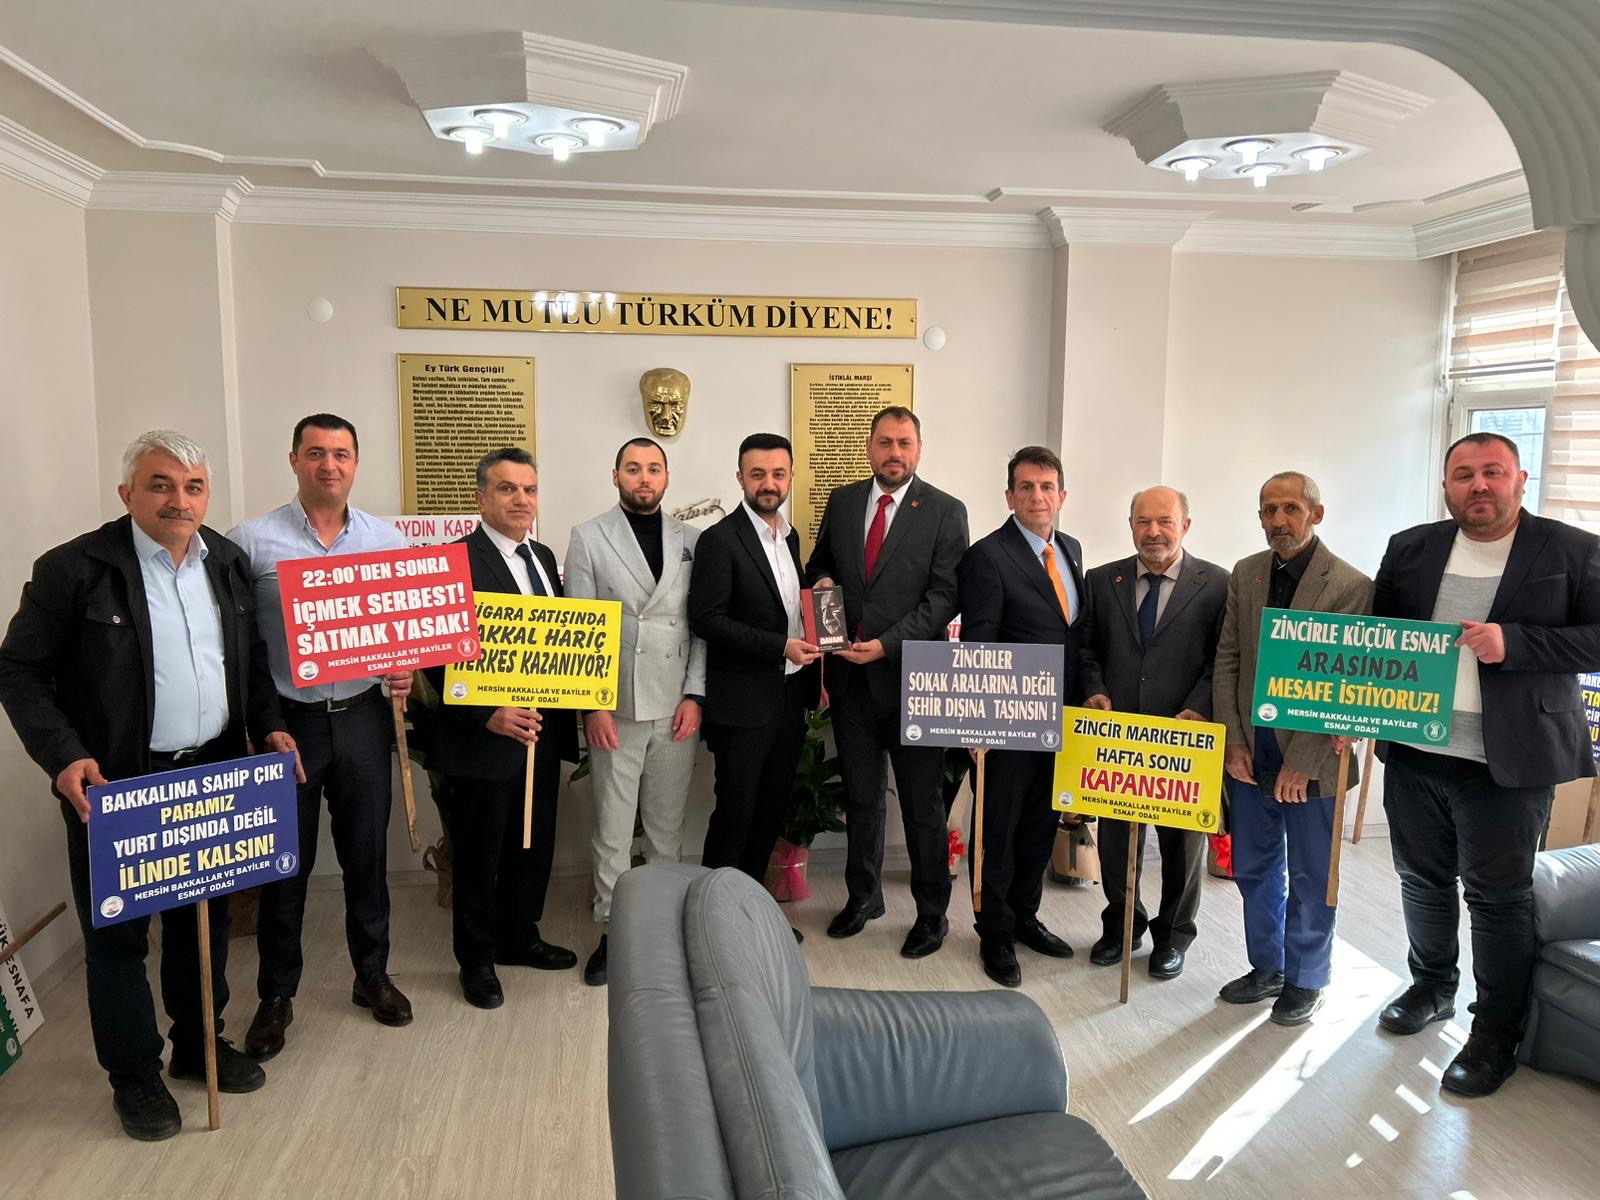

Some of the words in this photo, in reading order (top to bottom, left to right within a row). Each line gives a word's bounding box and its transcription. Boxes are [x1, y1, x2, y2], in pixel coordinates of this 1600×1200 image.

[425, 297, 471, 321] NE
[482, 299, 601, 325] MUTLU
[613, 297, 754, 328] TÜRKÜM
[766, 301, 892, 330] DİYENE!
[425, 364, 436, 373] Ey
[438, 365, 460, 373] Türk
[462, 365, 504, 374] Gençliği!
[394, 519, 435, 537] AYDIN
[302, 562, 392, 588] 22:00'DEN
[394, 556, 449, 579] SONRA
[292, 595, 363, 631] İÇMEK
[367, 582, 466, 615] SERBEST!
[474, 604, 523, 621] İGARA
[528, 608, 606, 628] SATIŞINDA
[297, 622, 389, 655] SATMAK
[392, 611, 470, 642] YASAK!
[478, 624, 537, 645] AKKAL
[544, 626, 607, 653] HARİÇ
[1271, 614, 1338, 644] ZİNCİRLE
[1342, 621, 1396, 653] KÜÇÜK
[1400, 631, 1451, 654] ESNAF
[328, 656, 358, 668] MERSİN
[360, 650, 408, 663] BAKKALLAR
[408, 648, 418, 656] VE
[420, 642, 452, 654] BAYİLER
[367, 662, 394, 672] ESNAF
[396, 656, 420, 667] ODASI
[520, 651, 612, 679] KAZANIYOR!
[952, 644, 1013, 670] ZİNCİRLER
[1297, 650, 1419, 682] ARASINDA
[477, 685, 506, 693] MERSİN
[507, 687, 549, 695] BAKKALLAR
[561, 688, 591, 696] BAYİLER
[908, 672, 948, 692] SOKAK
[951, 674, 1018, 695] ARALARINA
[1022, 671, 1057, 696] DEĞİL
[1267, 677, 1333, 702] MESAFE
[1339, 679, 1440, 714] İSTİYORUZ!
[907, 692, 942, 721] ŞEHİR
[945, 698, 986, 723] DIŞINA
[994, 700, 1048, 725] TAŞINSIN
[1287, 708, 1318, 719] MERSİN
[1319, 712, 1369, 724] BAKKALLAR
[1370, 717, 1381, 725] VE
[1382, 717, 1418, 729] BAYİLER
[929, 727, 956, 735] MERSİN
[956, 728, 997, 737] BAKKALLAR
[1007, 730, 1037, 739] BAYİLER
[1073, 716, 1122, 739] ZİNCİR
[1126, 725, 1215, 750] MARKETLER
[1324, 722, 1351, 731] ESNAF
[1354, 725, 1379, 734] ODASI
[1096, 747, 1144, 767] HAFTA
[1149, 754, 1192, 773] SONU
[102, 780, 198, 814] BAKKALINA
[202, 768, 249, 793] SAHİP
[254, 763, 284, 786] ÇIK!
[1080, 767, 1200, 804] KAPANSIN!
[160, 794, 235, 825] PARAMIZ
[1082, 795, 1107, 805] MERSİN
[1109, 799, 1150, 811] BAKKALLAR
[1162, 806, 1192, 817] BAYİLER
[1113, 808, 1136, 817] ESNAF
[1138, 812, 1160, 820] ODASI
[113, 833, 157, 858] YURT
[162, 818, 229, 846] DIŞINDA
[234, 806, 276, 830] DEĞİL
[119, 853, 190, 891] İLİNDE
[198, 834, 274, 872] KALSIN!
[134, 886, 170, 902] MERSİN
[171, 872, 223, 892] BAKKALLAR
[224, 869, 235, 880] VE
[236, 860, 270, 876] BAYİLER
[177, 887, 206, 900] ESNAF
[209, 879, 235, 893] ODASI
